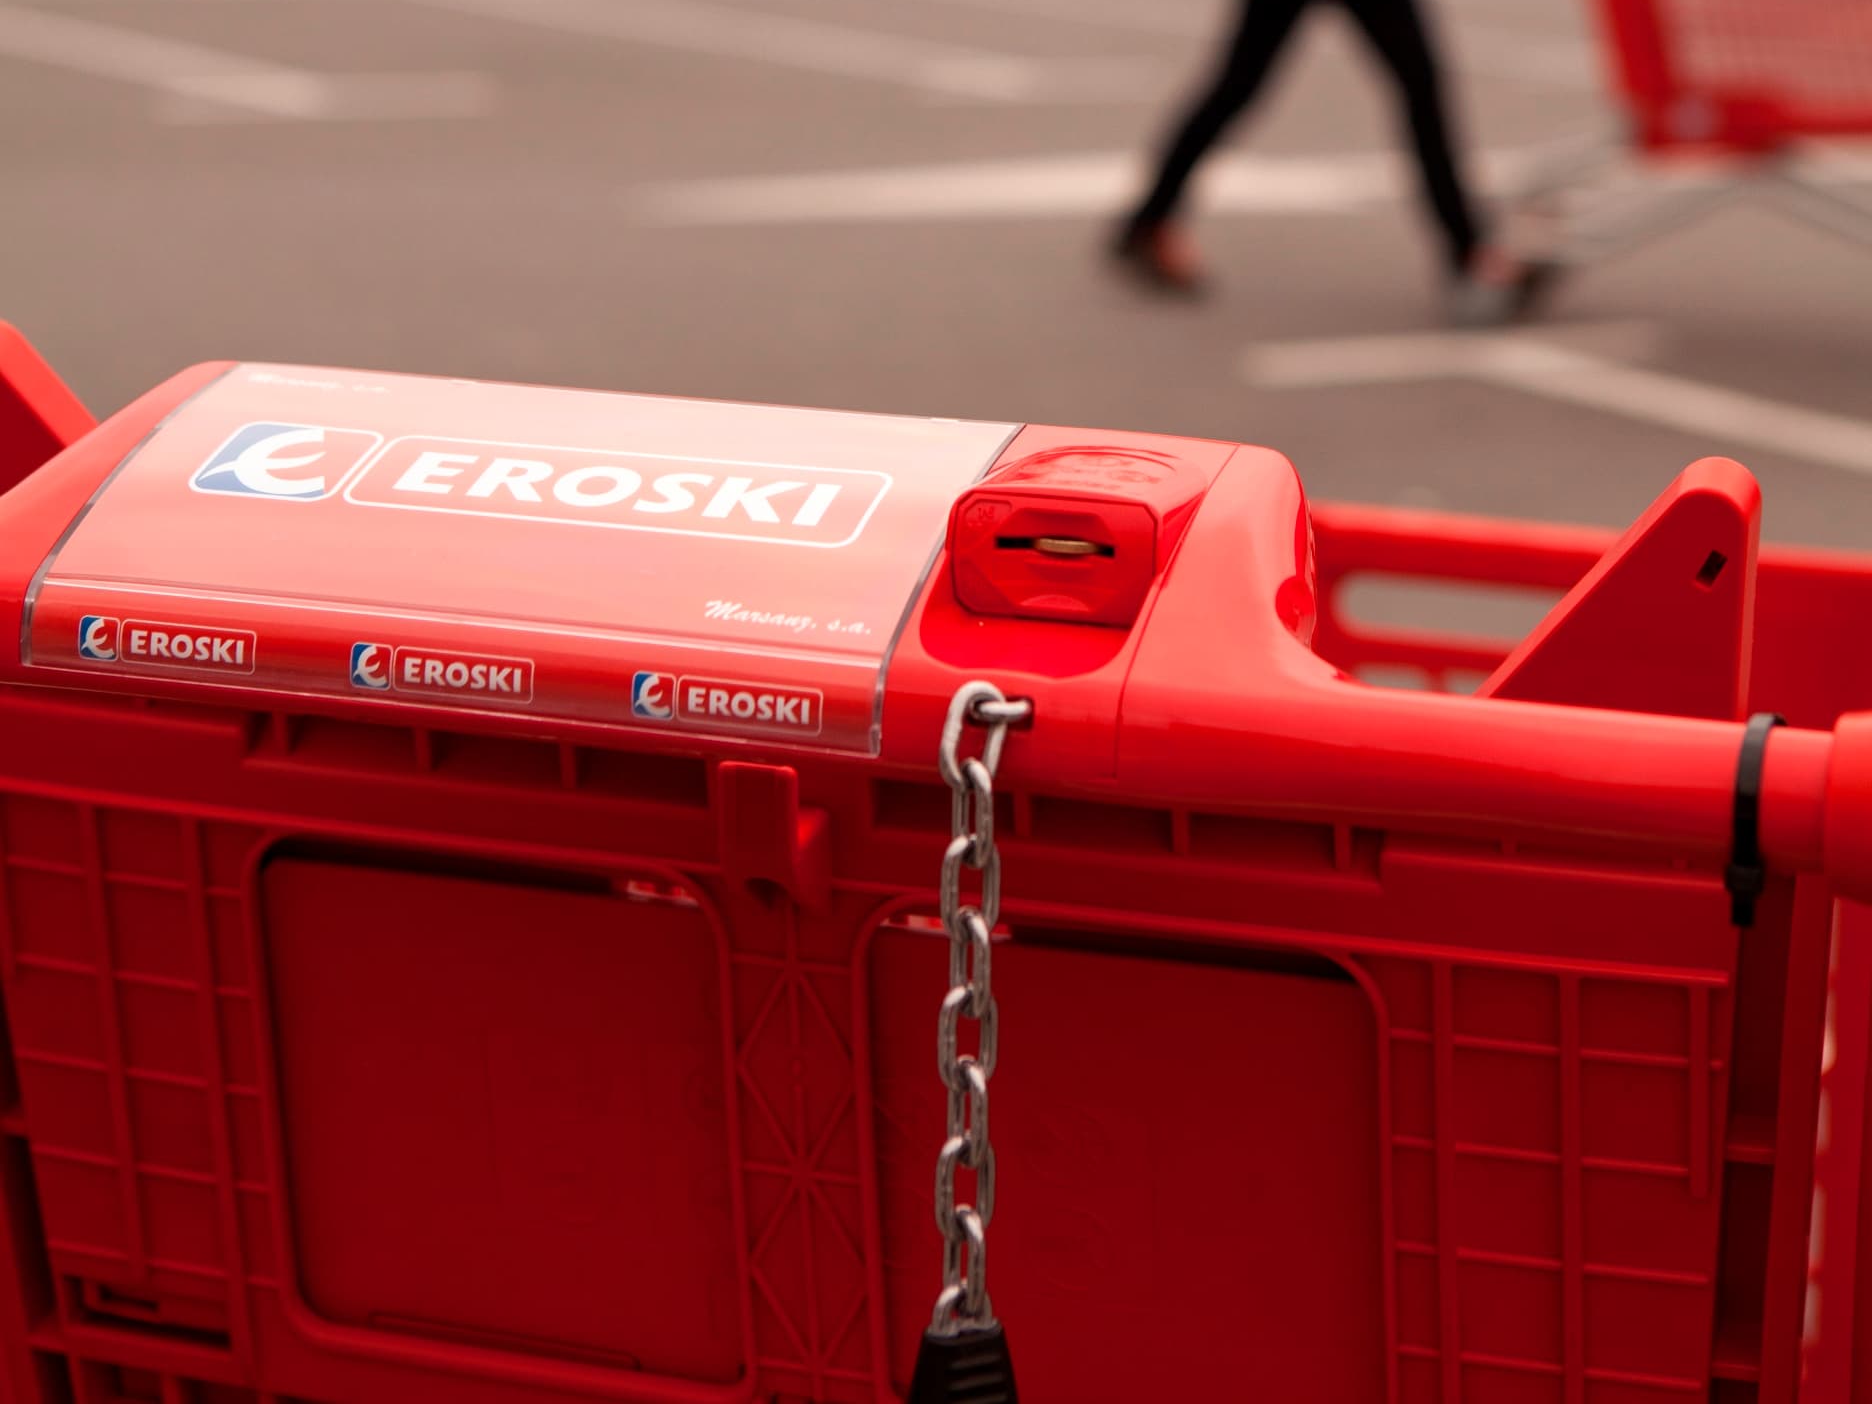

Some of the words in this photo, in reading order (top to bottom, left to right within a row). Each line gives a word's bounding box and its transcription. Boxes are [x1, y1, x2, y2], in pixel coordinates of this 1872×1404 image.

[393, 451, 842, 526] EROSKI
[130, 629, 245, 664] EROSKI
[403, 657, 522, 693] EROSKI
[687, 687, 811, 724] EROSKI
